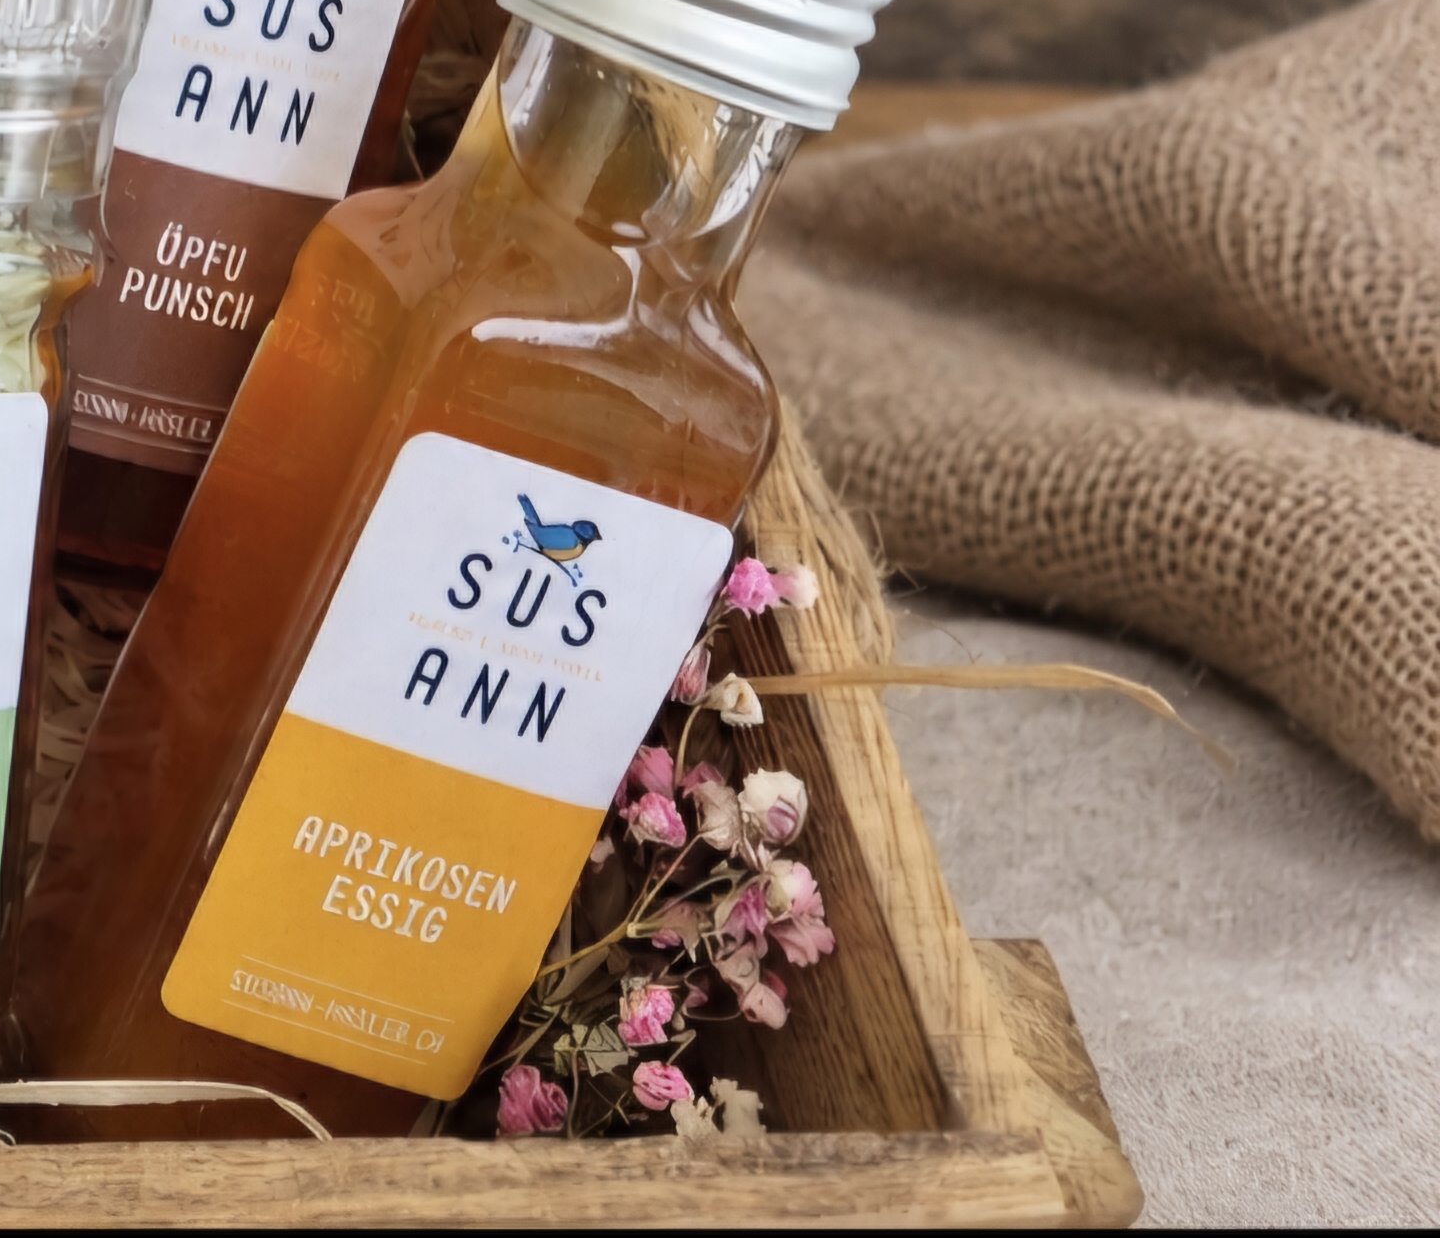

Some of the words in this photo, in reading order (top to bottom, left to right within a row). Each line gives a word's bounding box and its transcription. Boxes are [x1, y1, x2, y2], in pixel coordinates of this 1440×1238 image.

[175, 65, 316, 146] ANN
[157, 222, 247, 281] ÖPFU
[120, 267, 254, 331] PUNSCH
[447, 553, 607, 647] SUS
[404, 647, 566, 743] ANN
[293, 815, 517, 914] APRIKOSEN
[322, 875, 448, 943] ESSIG
